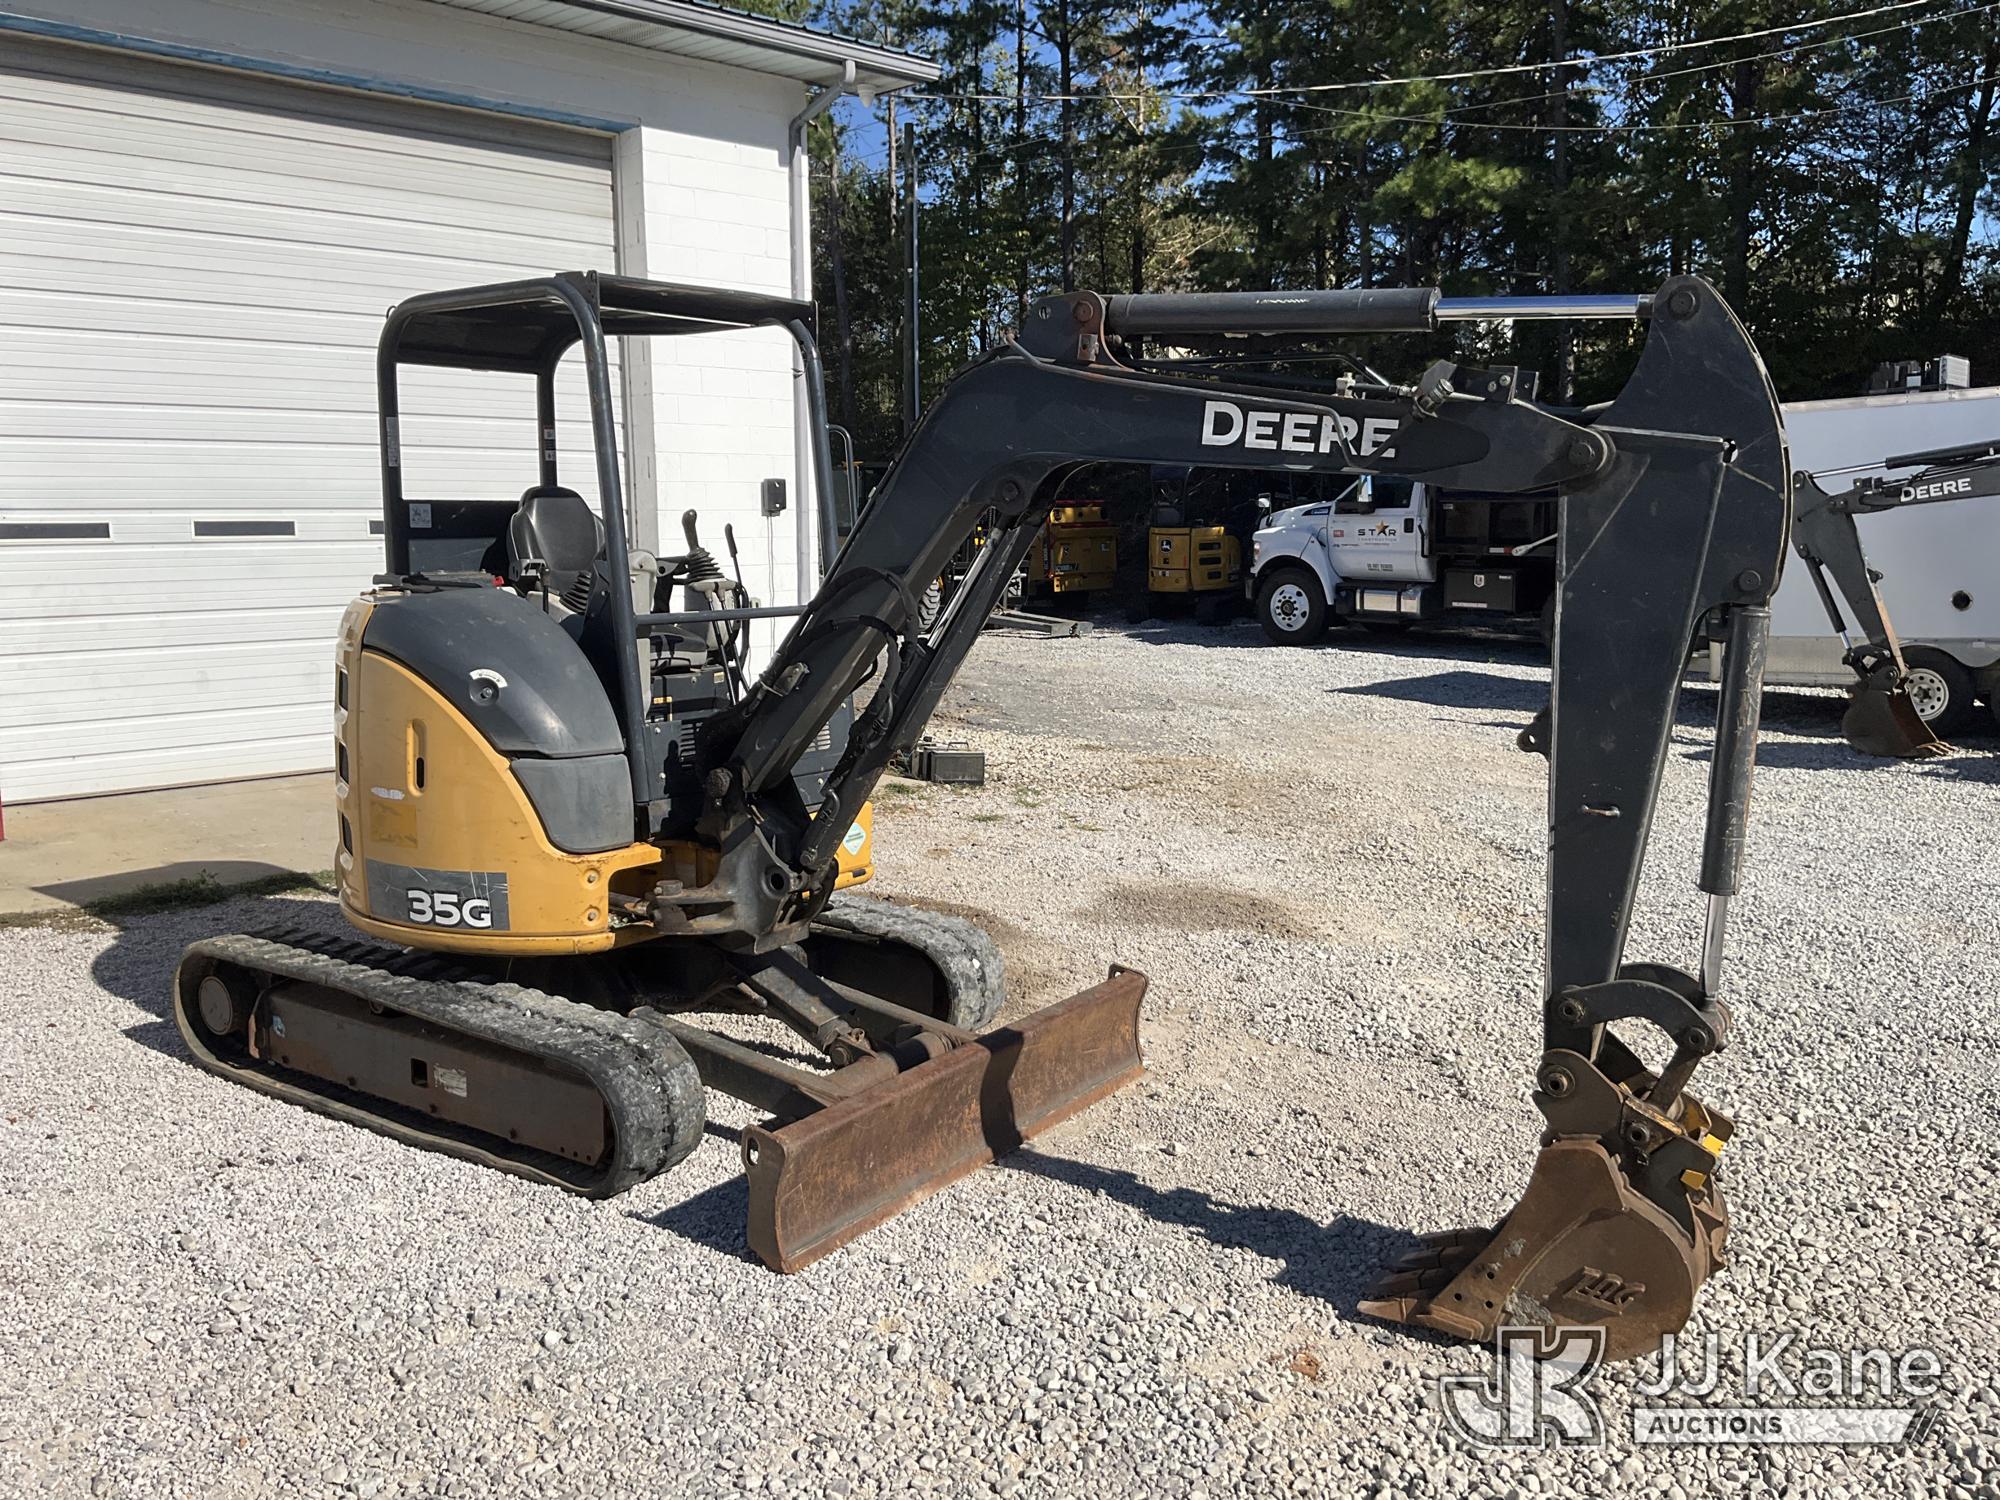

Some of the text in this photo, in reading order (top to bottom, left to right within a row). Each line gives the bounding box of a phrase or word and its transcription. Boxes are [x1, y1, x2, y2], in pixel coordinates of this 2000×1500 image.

[1201, 401, 1400, 458] DEERE
[1900, 478, 1972, 502] DEERE
[1357, 522, 1397, 537] STAR
[407, 889, 493, 928] 35G
